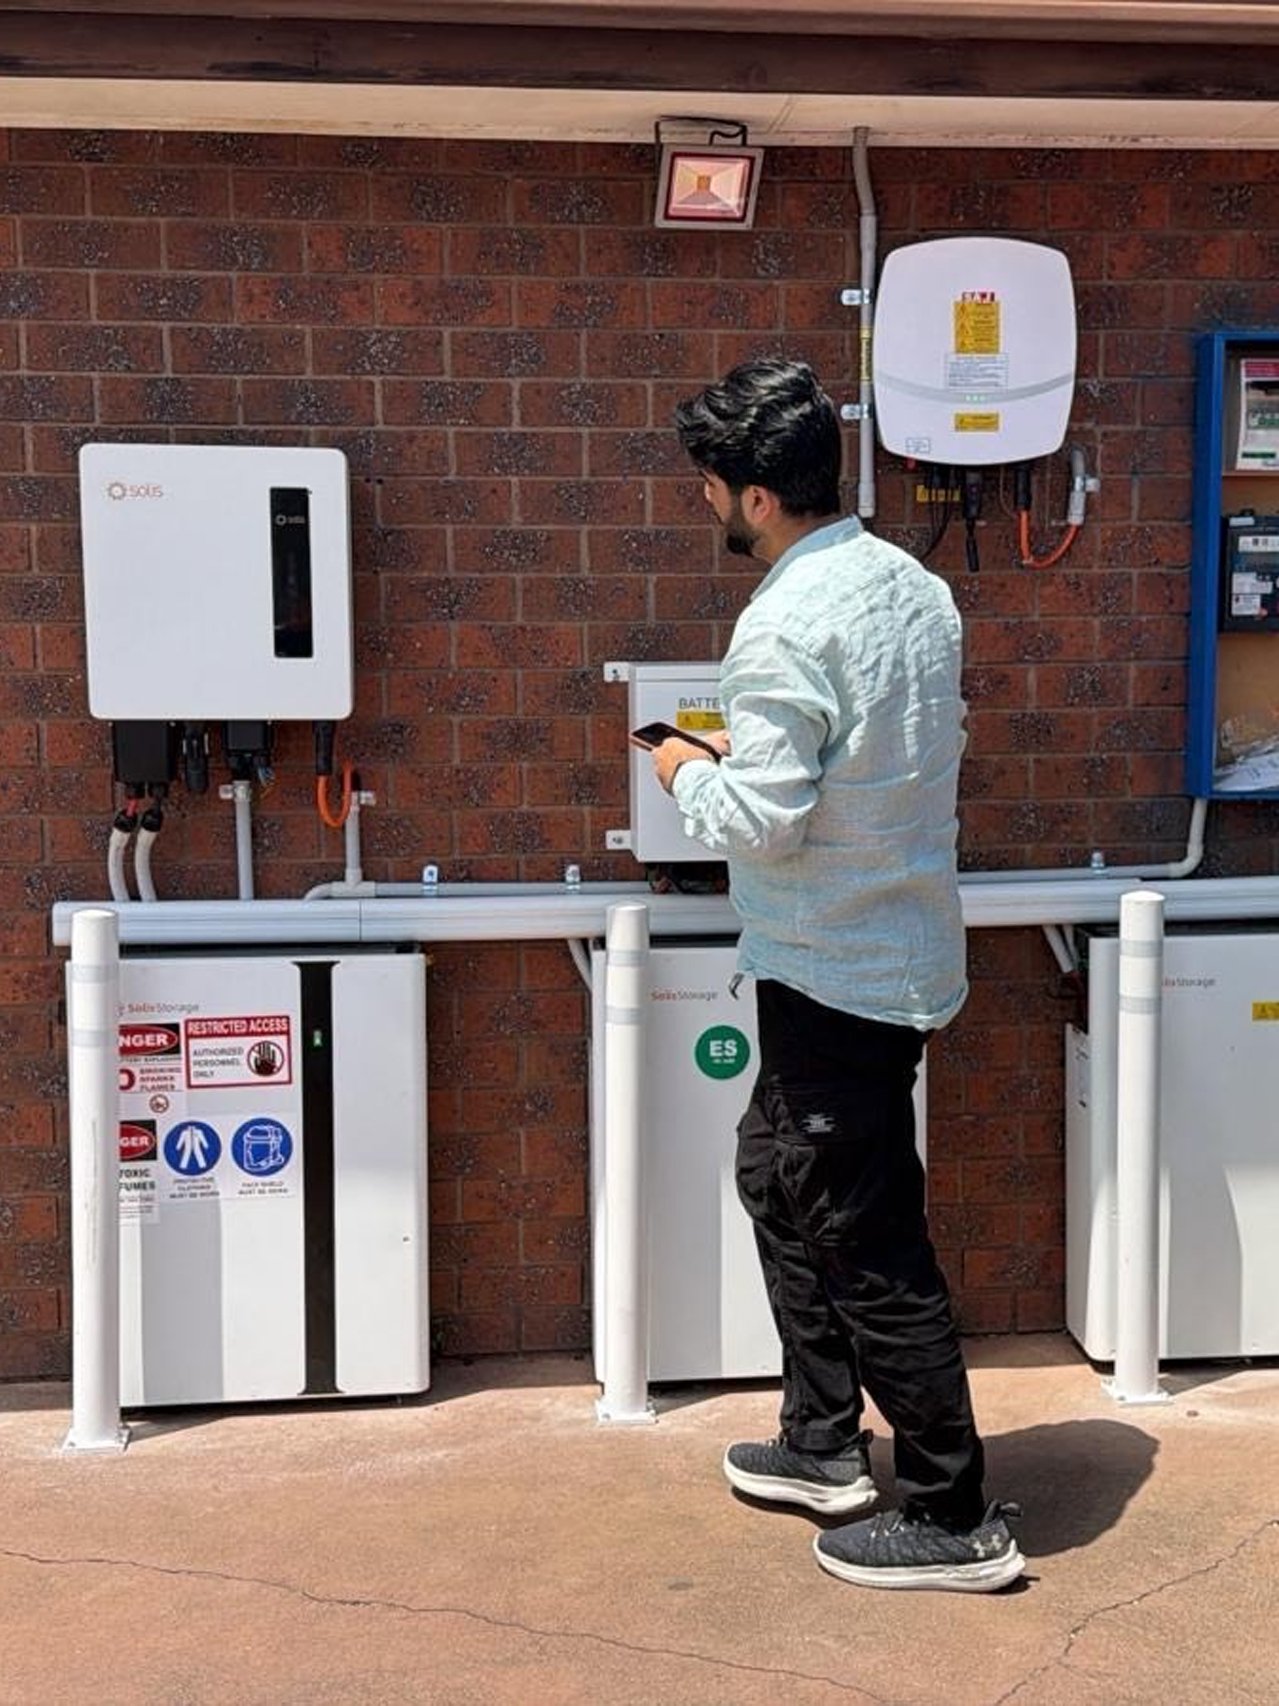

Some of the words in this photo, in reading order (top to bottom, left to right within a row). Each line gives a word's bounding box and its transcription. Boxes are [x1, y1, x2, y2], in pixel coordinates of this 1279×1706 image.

[129, 484, 163, 498] solis
[678, 697, 721, 709] BATTE
[187, 1021, 248, 1035] RESTRICTED
[249, 1018, 289, 1033] ACCESS
[118, 1033, 169, 1048] NGER
[193, 1047, 244, 1057] AUTHORIZED
[709, 1039, 738, 1057] ES
[193, 1058, 241, 1067] PERSONNEL
[193, 1070, 214, 1078] ONLY
[119, 1136, 149, 1148] GER
